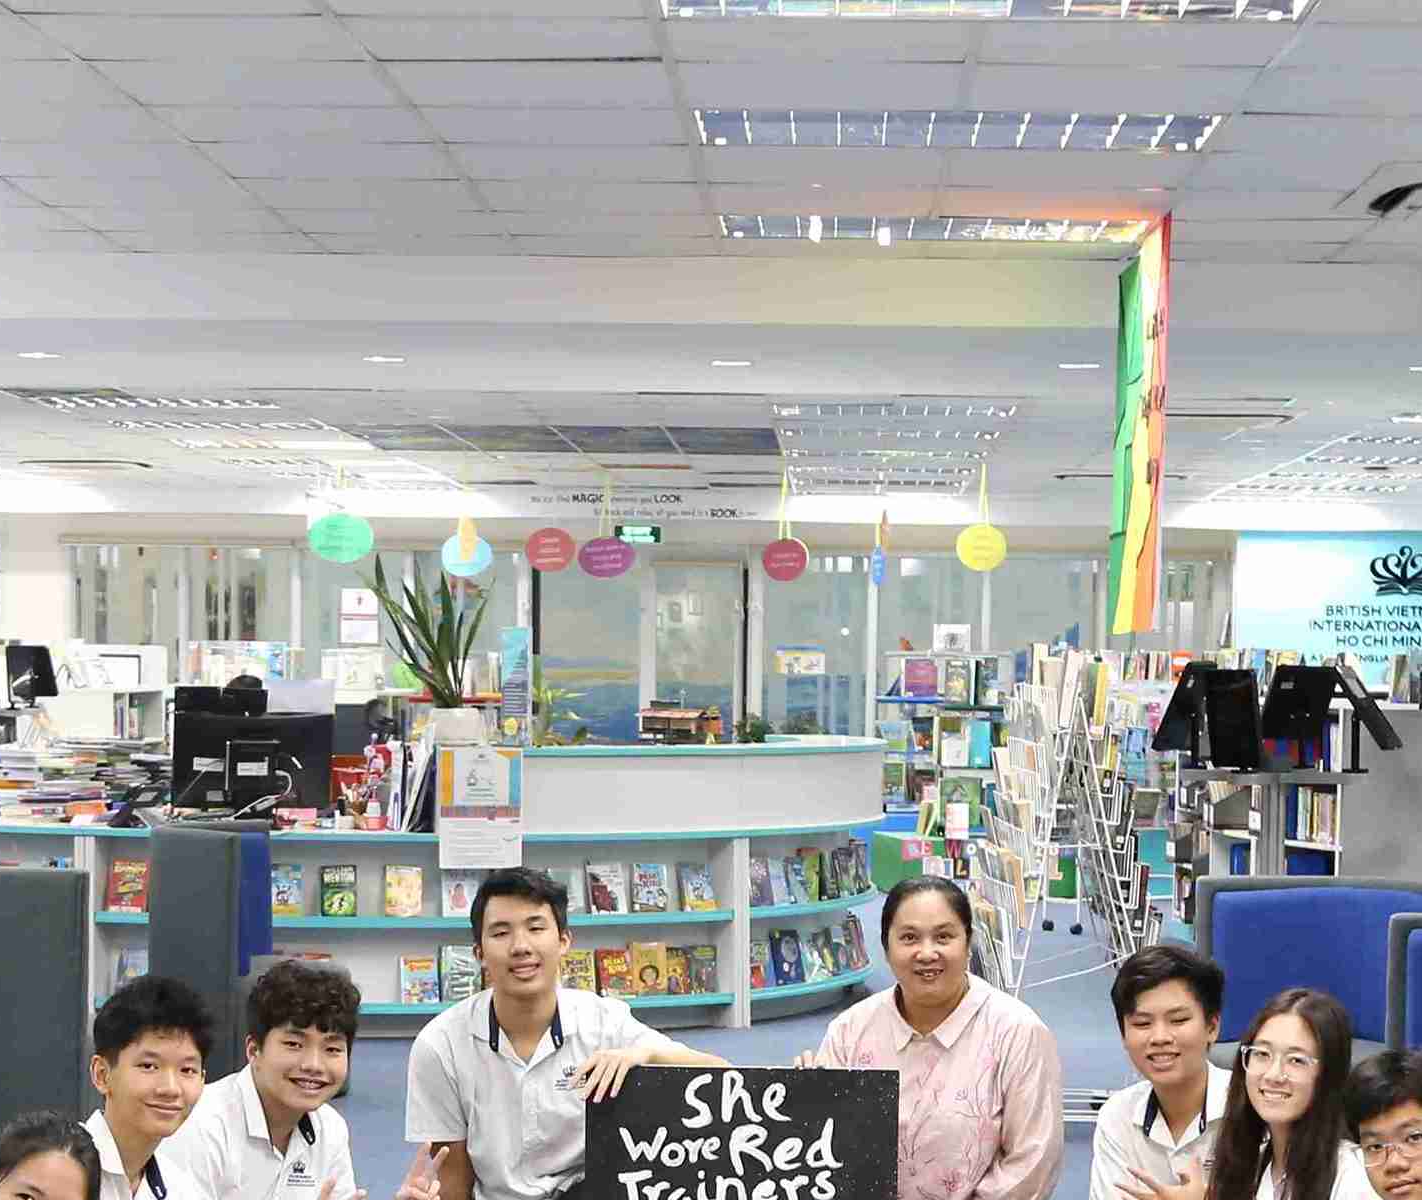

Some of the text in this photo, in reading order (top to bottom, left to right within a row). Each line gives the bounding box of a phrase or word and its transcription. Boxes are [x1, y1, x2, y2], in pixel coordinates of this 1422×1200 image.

[1326, 605, 1382, 617] BRITISH
[1336, 635, 1359, 647] HO
[1362, 635, 1388, 647] CHI
[680, 1069, 792, 1129] She
[618, 1116, 844, 1177] Wore Red
